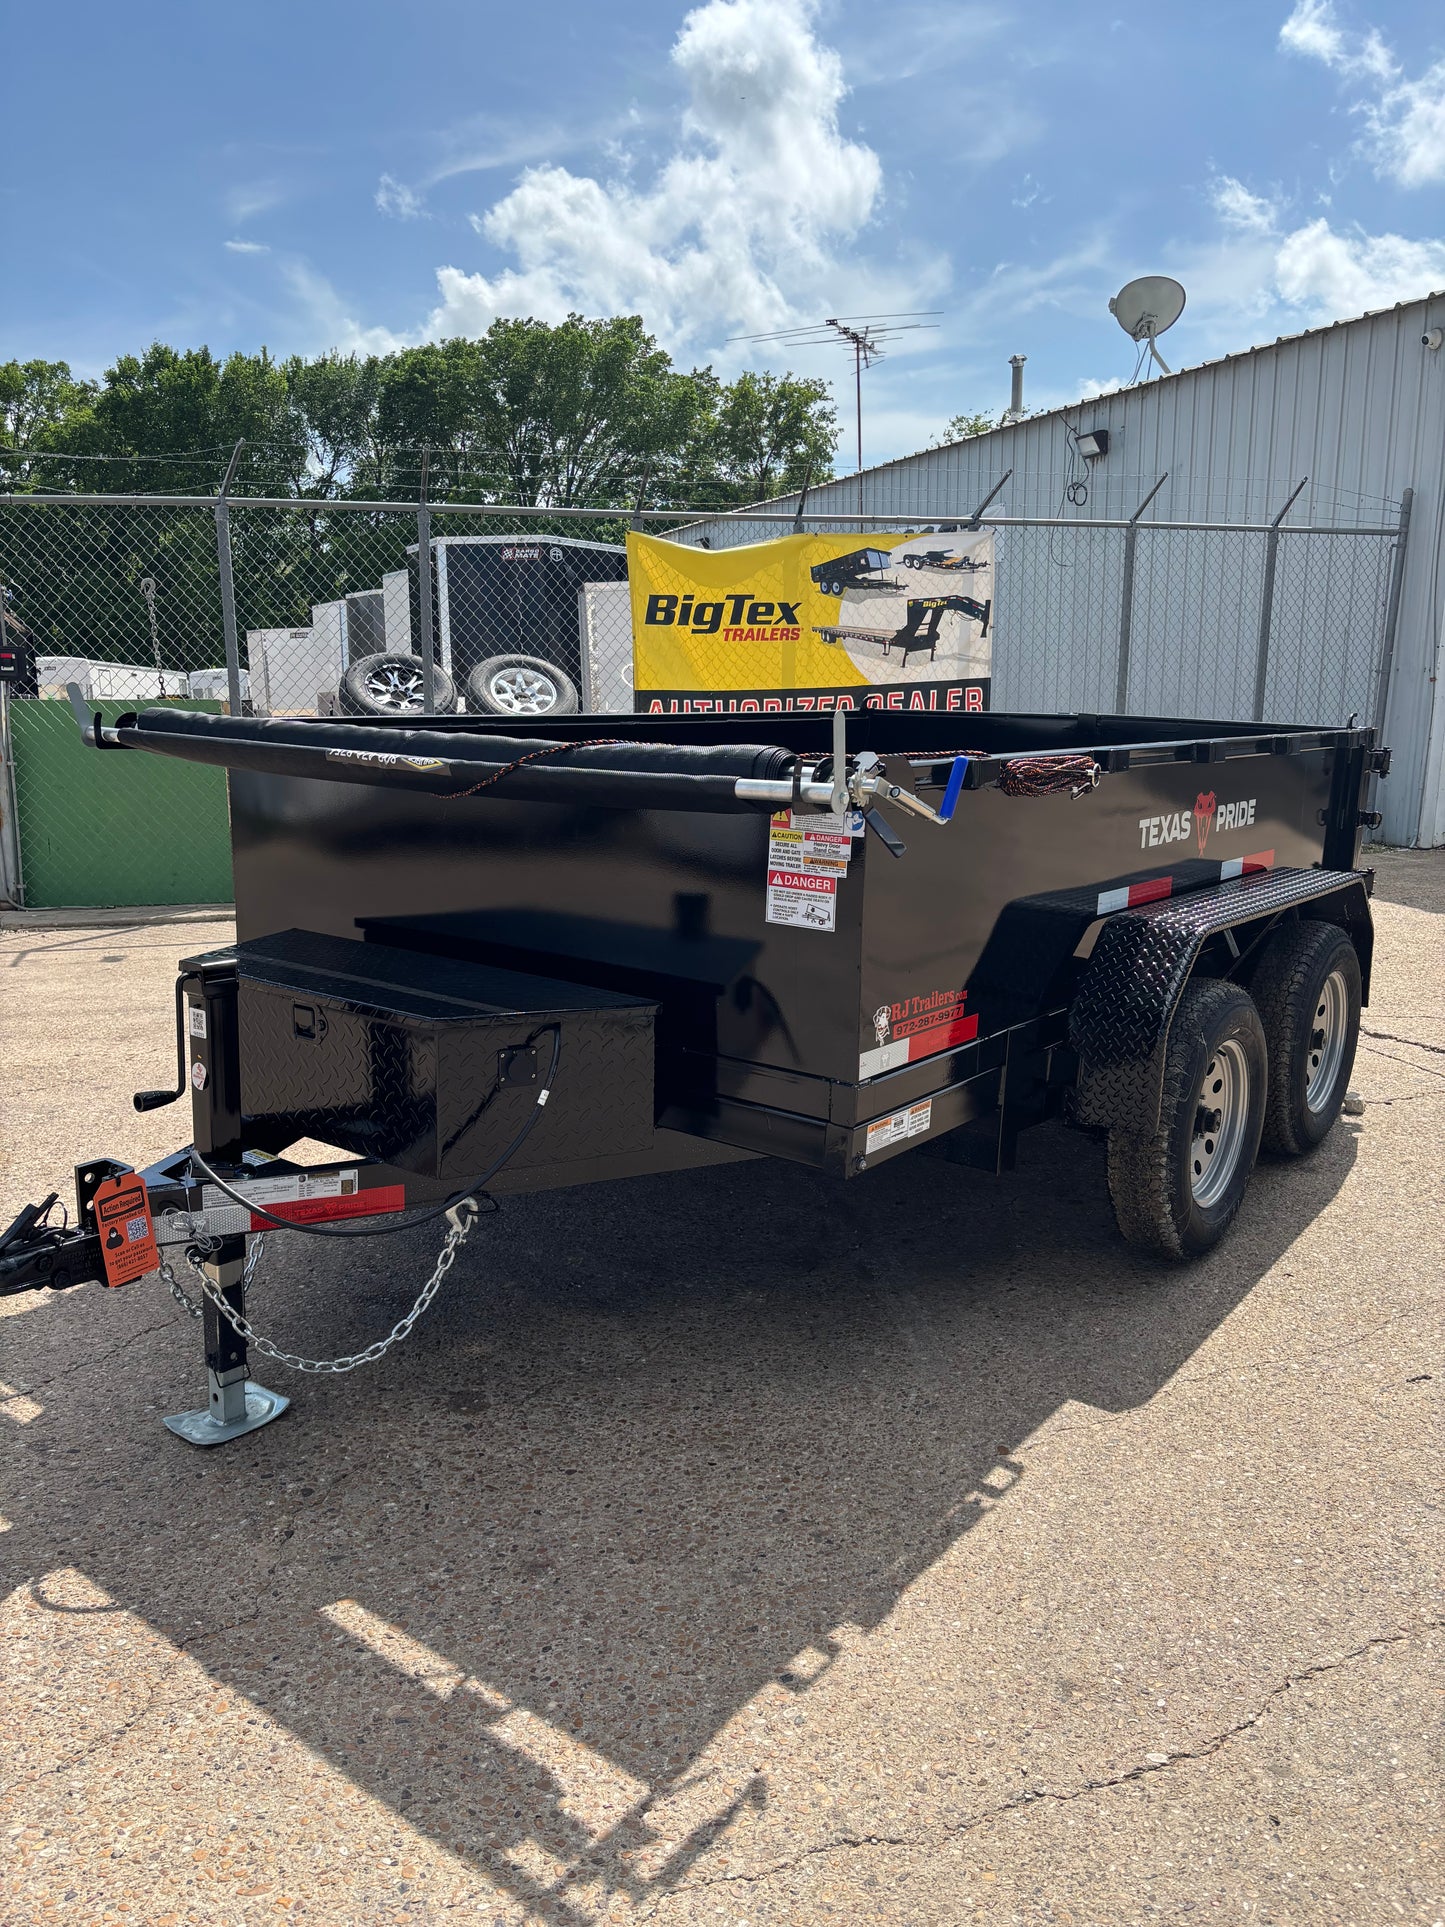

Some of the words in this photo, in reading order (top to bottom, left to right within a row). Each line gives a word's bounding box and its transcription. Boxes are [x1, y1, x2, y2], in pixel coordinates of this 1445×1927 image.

[644, 594, 802, 634] BigTex
[723, 627, 801, 642] TRAILERS
[1138, 810, 1192, 849] TEXAS
[1215, 798, 1257, 833] PRIDE
[777, 832, 803, 840] CAUTION
[816, 834, 843, 843] DANGER
[813, 858, 839, 867] WARNING
[784, 874, 831, 891] DANGER
[891, 999, 910, 1022] RJ
[896, 1006, 962, 1036] 972-287-9977
[103, 1201, 120, 1214] Action
[119, 1193, 141, 1209] Required
[294, 1206, 324, 1218] TEXAS
[338, 1200, 367, 1212] PRIDE
[102, 1219, 118, 1229] Factory
[118, 1211, 137, 1223] Installed
[138, 1208, 147, 1217] GPS
[114, 1250, 126, 1258] Scan
[114, 1258, 122, 1266] get
[122, 1254, 134, 1262] your
[133, 1245, 153, 1257] password
